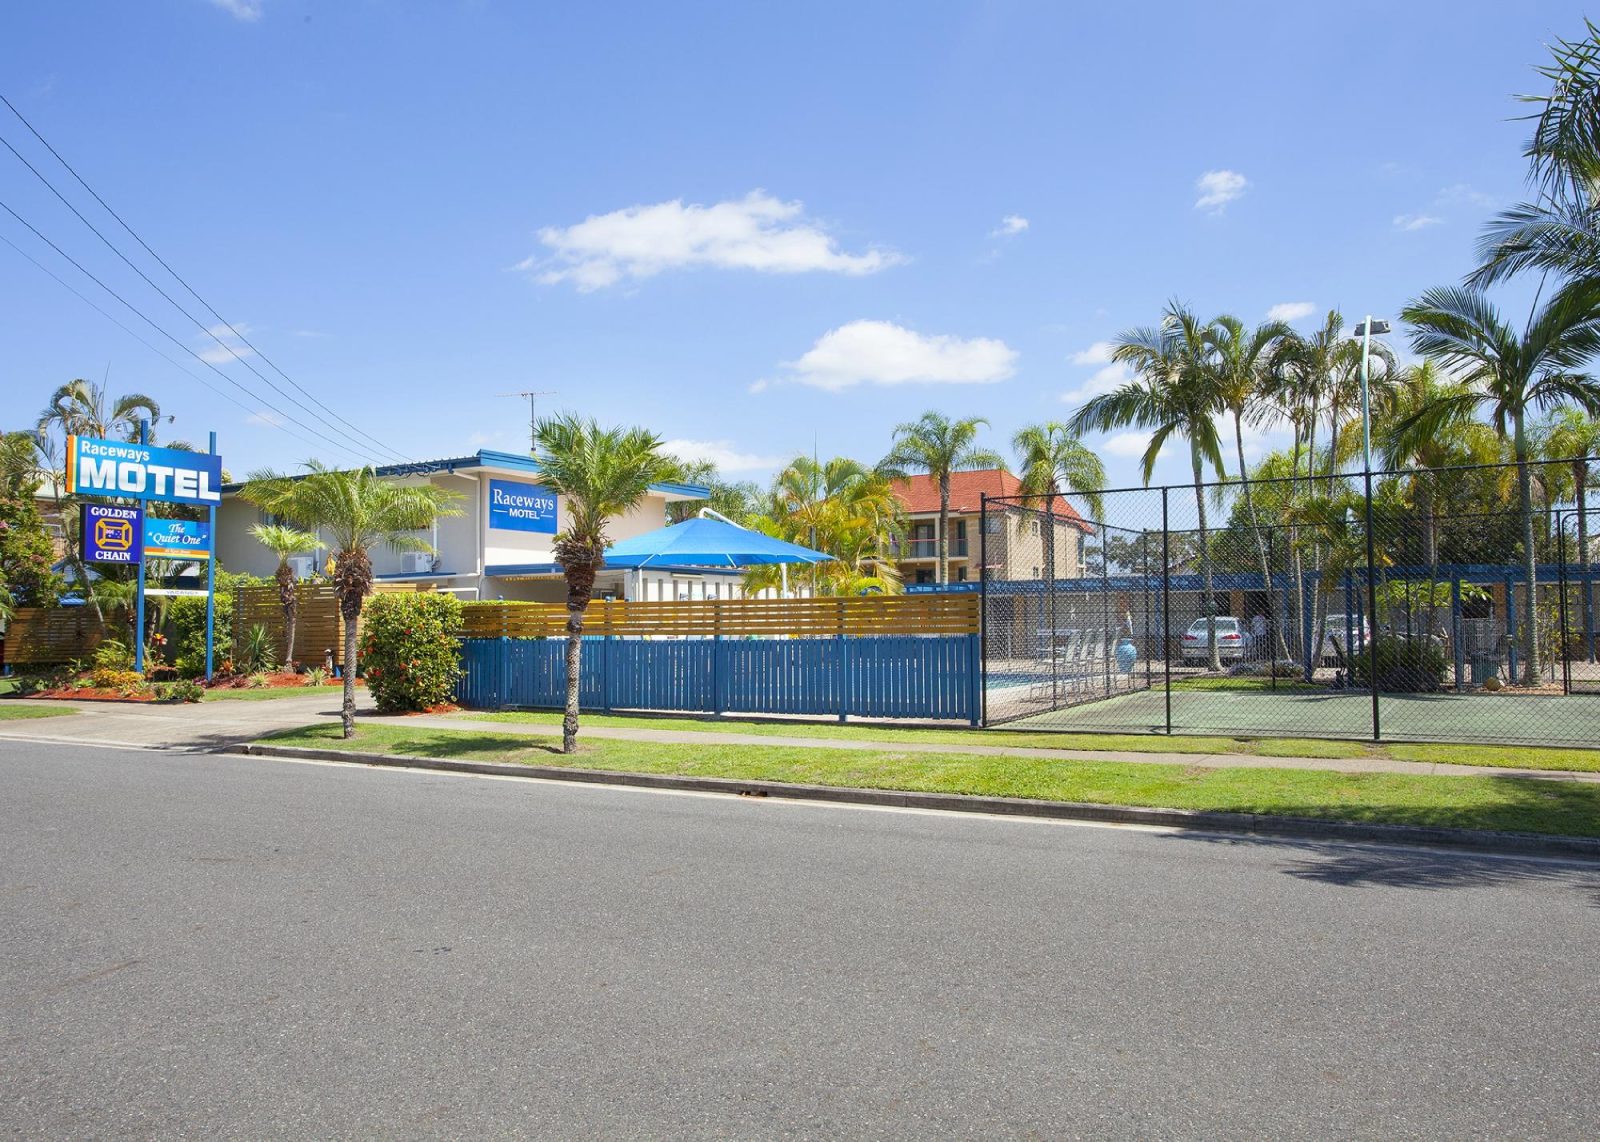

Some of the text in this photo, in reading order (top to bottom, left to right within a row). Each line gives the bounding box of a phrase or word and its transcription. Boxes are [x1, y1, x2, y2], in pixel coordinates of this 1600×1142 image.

[81, 440, 150, 462] Raceways
[79, 456, 220, 501] MOTEL
[493, 488, 554, 513] Raceways
[90, 506, 137, 519] GOLDEN
[509, 507, 540, 520] MOTEL
[168, 523, 185, 533] The
[95, 551, 131, 560] CHAIN
